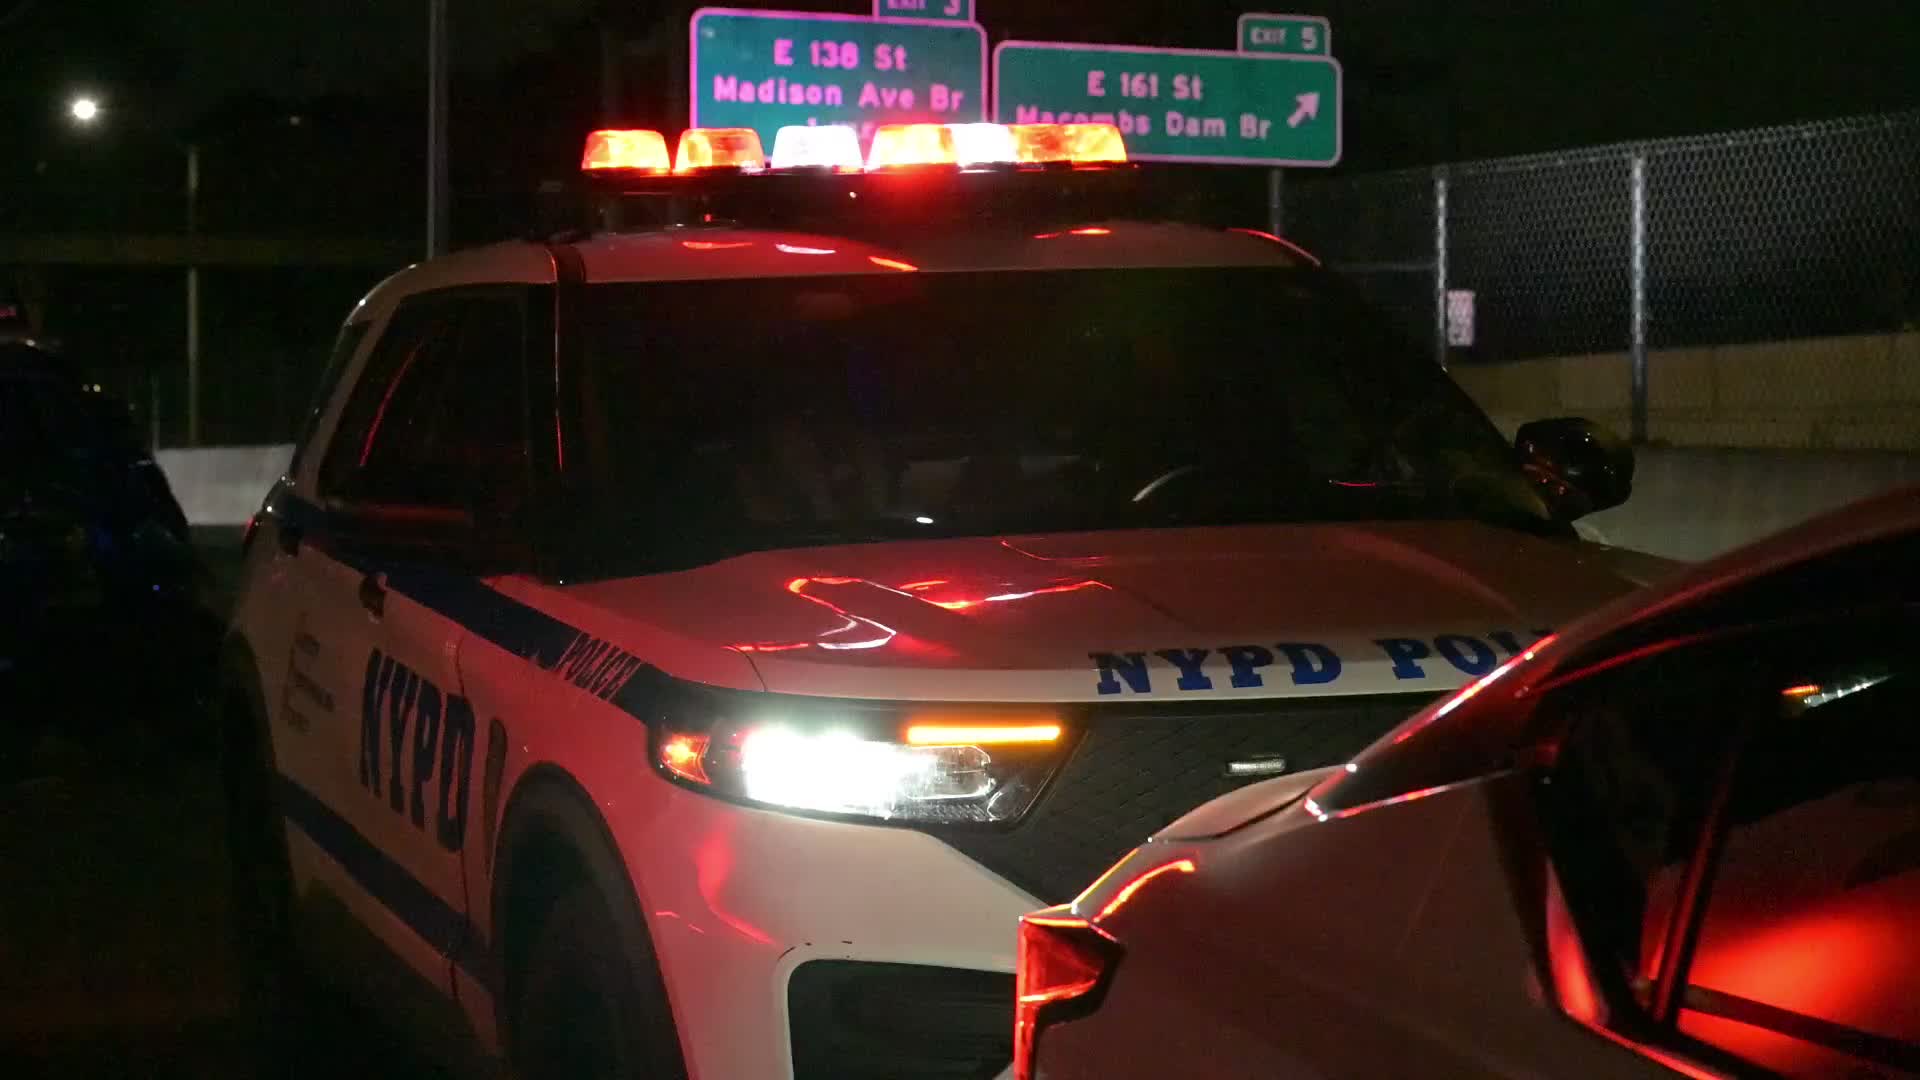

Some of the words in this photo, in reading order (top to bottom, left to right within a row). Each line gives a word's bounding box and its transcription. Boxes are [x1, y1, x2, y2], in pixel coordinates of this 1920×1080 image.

[773, 38, 794, 66] E
[810, 40, 860, 69] 138
[874, 43, 908, 71] St
[1302, 26, 1318, 50] 5
[713, 74, 843, 107] Madison
[858, 82, 915, 109] Ave
[929, 83, 966, 112] Br
[1086, 70, 1105, 97] E
[1121, 72, 1159, 99] 161
[1173, 74, 1203, 100] St
[1165, 111, 1226, 138] Dam
[1240, 113, 1272, 139] Br
[556, 631, 641, 701] POLICE
[1088, 642, 1342, 695] NYPD
[359, 647, 475, 854] NYPD
